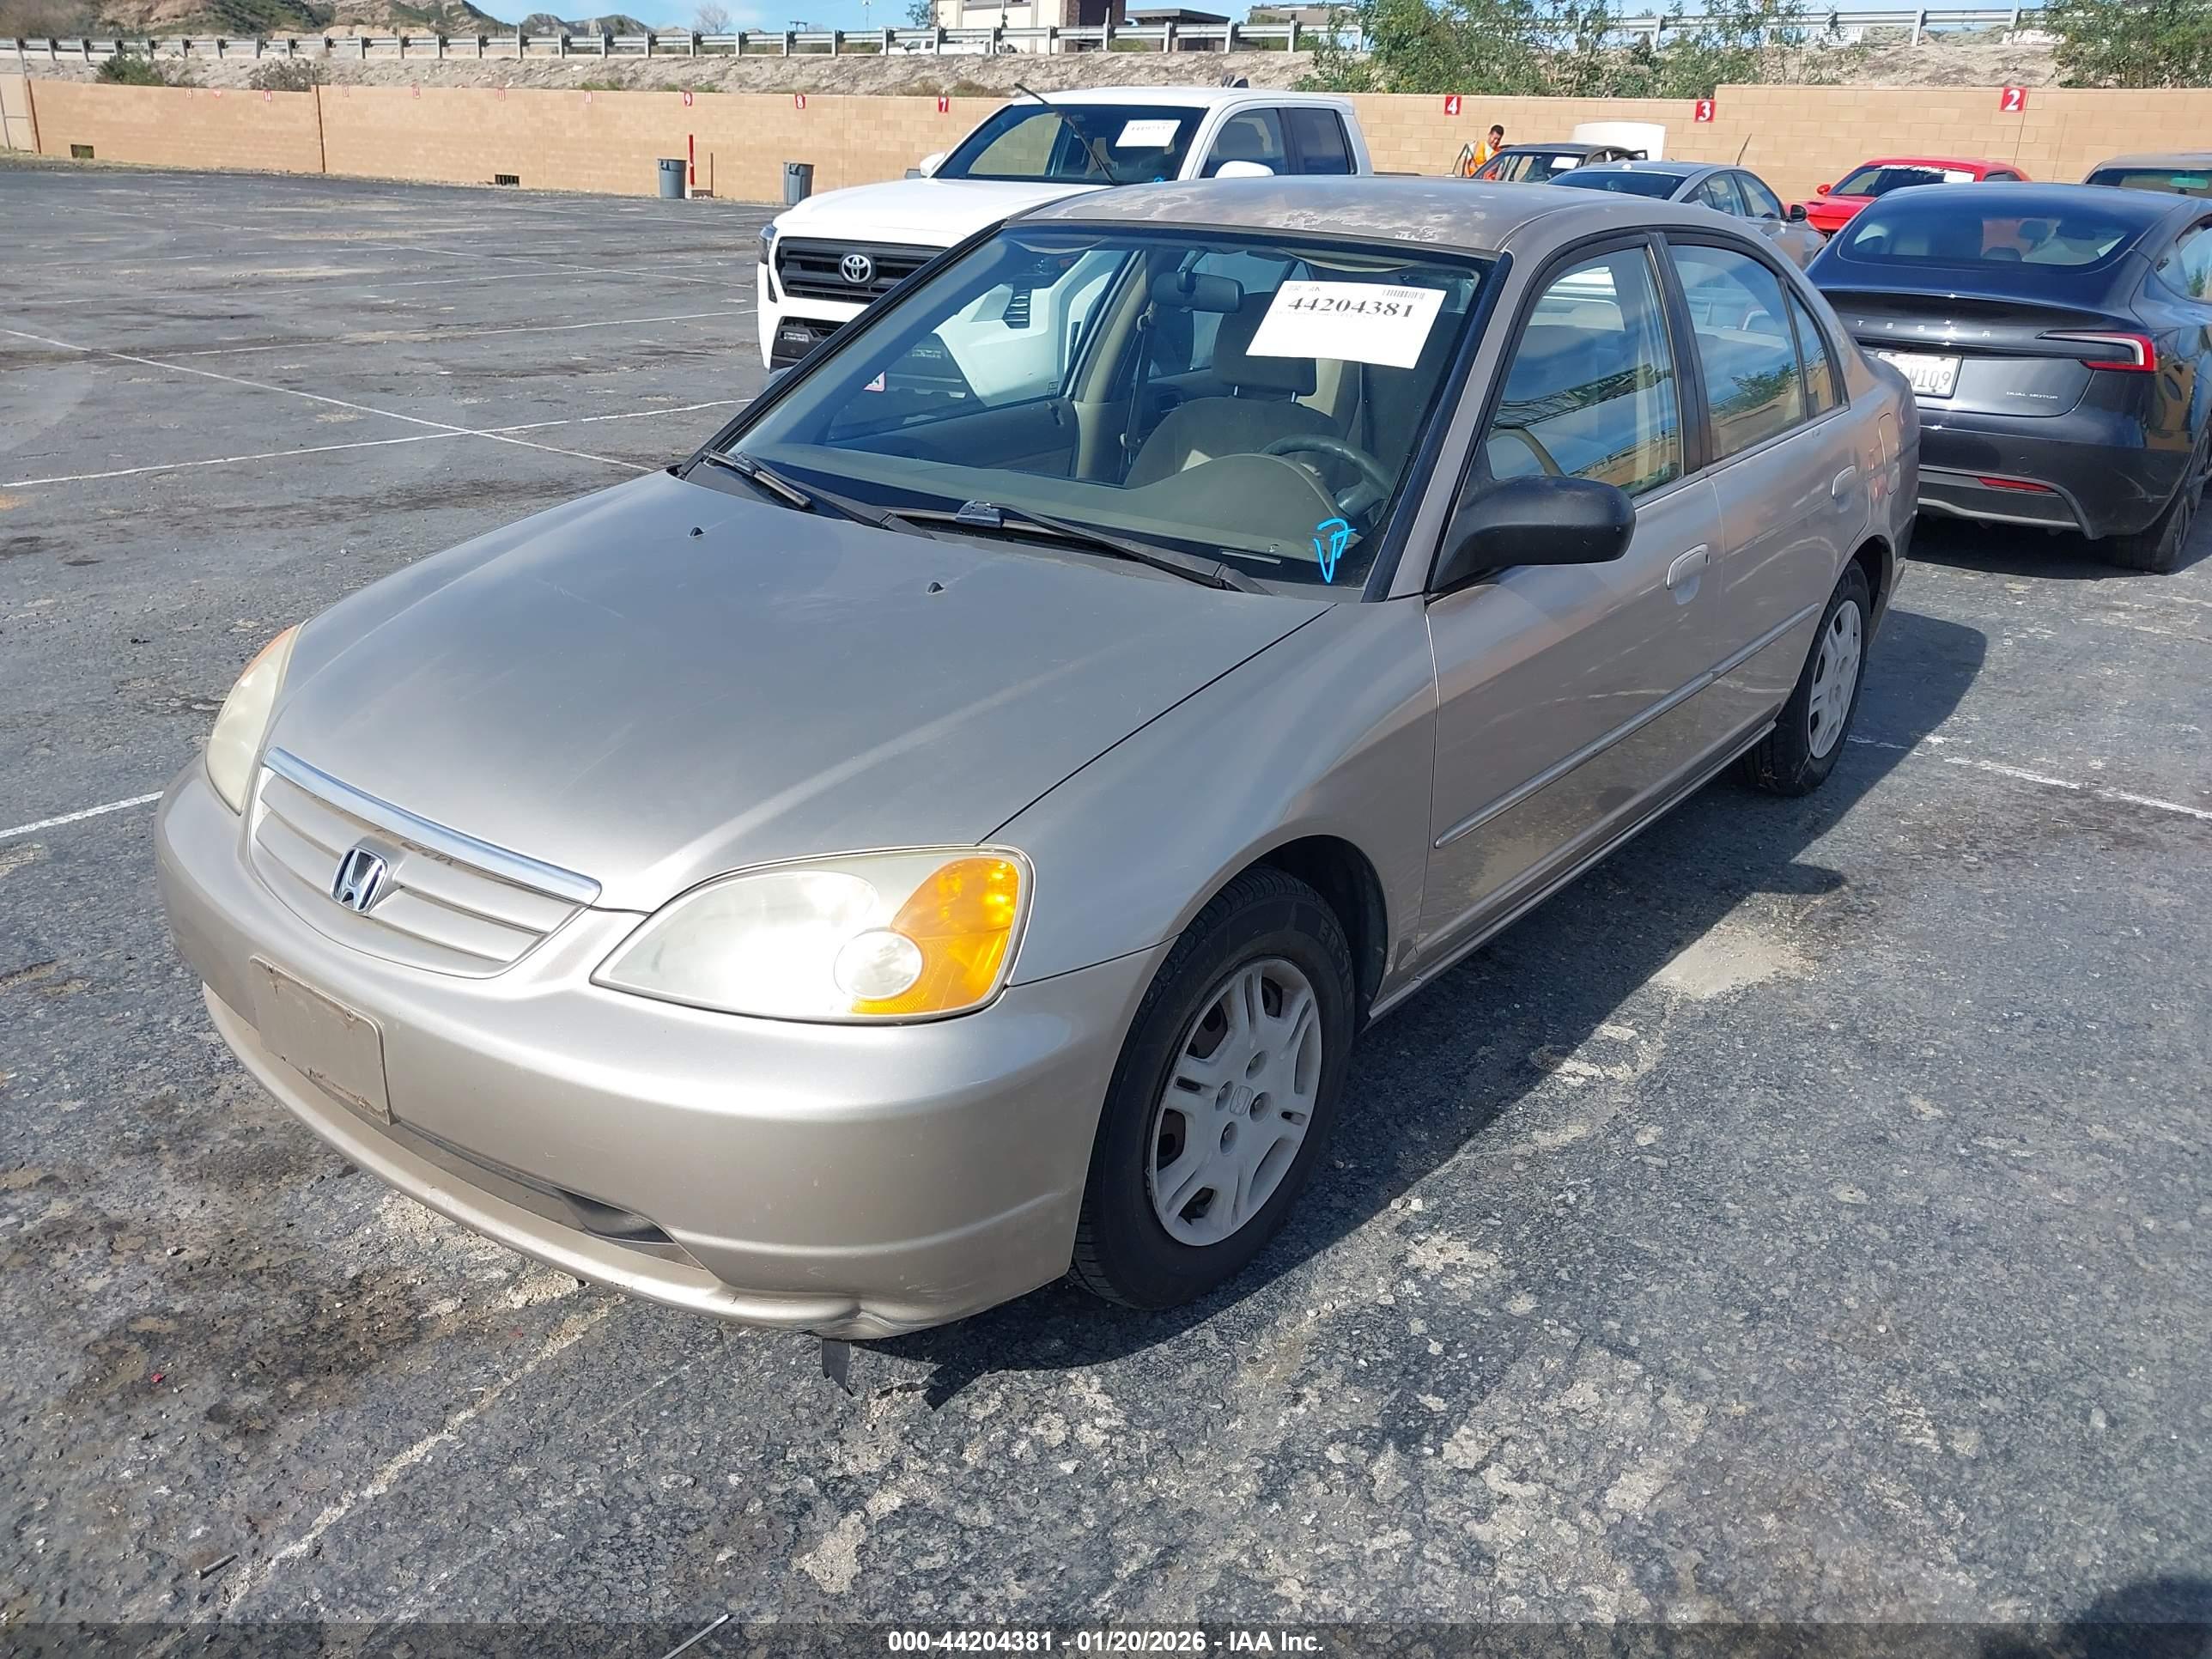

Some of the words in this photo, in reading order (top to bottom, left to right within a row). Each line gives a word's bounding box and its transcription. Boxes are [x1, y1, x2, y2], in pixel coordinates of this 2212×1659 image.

[796, 94, 804, 109] 8
[939, 96, 947, 112] 7
[1447, 96, 1458, 114] 4
[2003, 89, 2021, 111] 2
[1698, 101, 1711, 121] 3
[1287, 297, 1413, 318] 44204381
[1856, 319, 1990, 337] TESA
